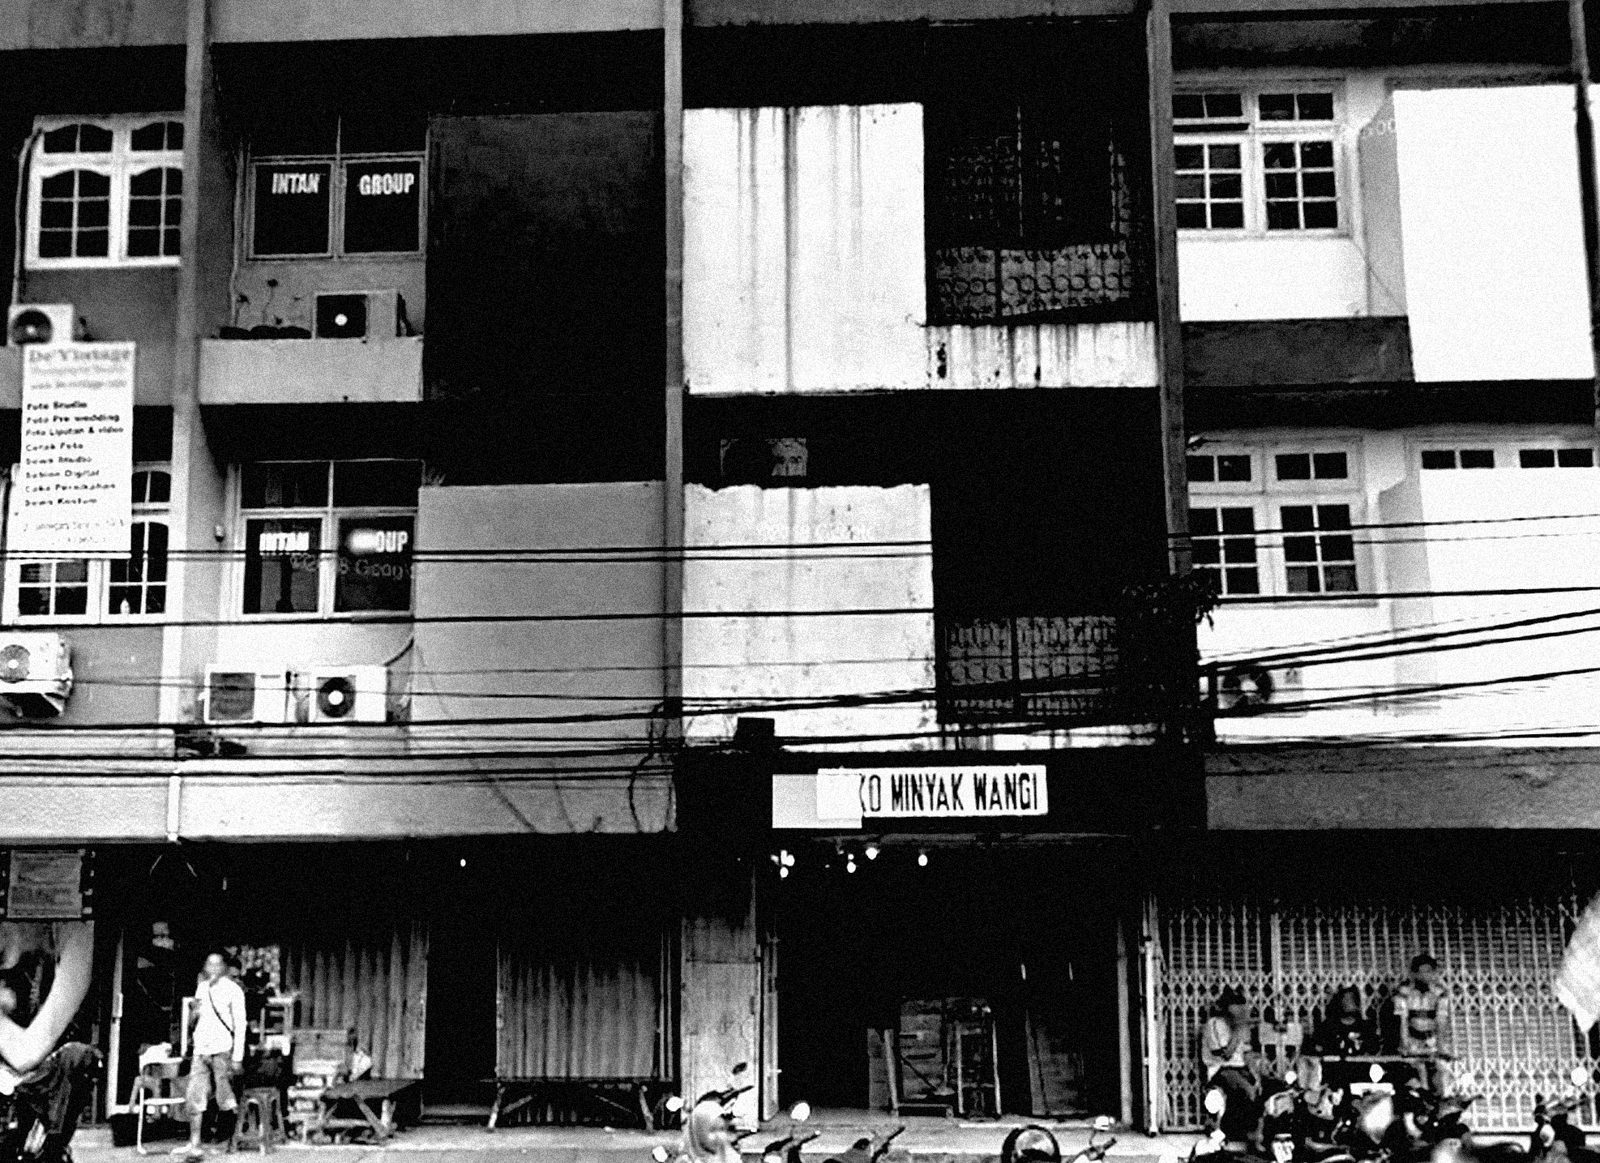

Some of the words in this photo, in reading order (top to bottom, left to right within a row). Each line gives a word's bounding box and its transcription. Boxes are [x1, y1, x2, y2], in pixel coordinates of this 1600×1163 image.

[272, 172, 321, 194] INTAN
[359, 172, 415, 196] GROUP
[891, 773, 964, 812] MINYAK
[973, 772, 1038, 811] WANGI
